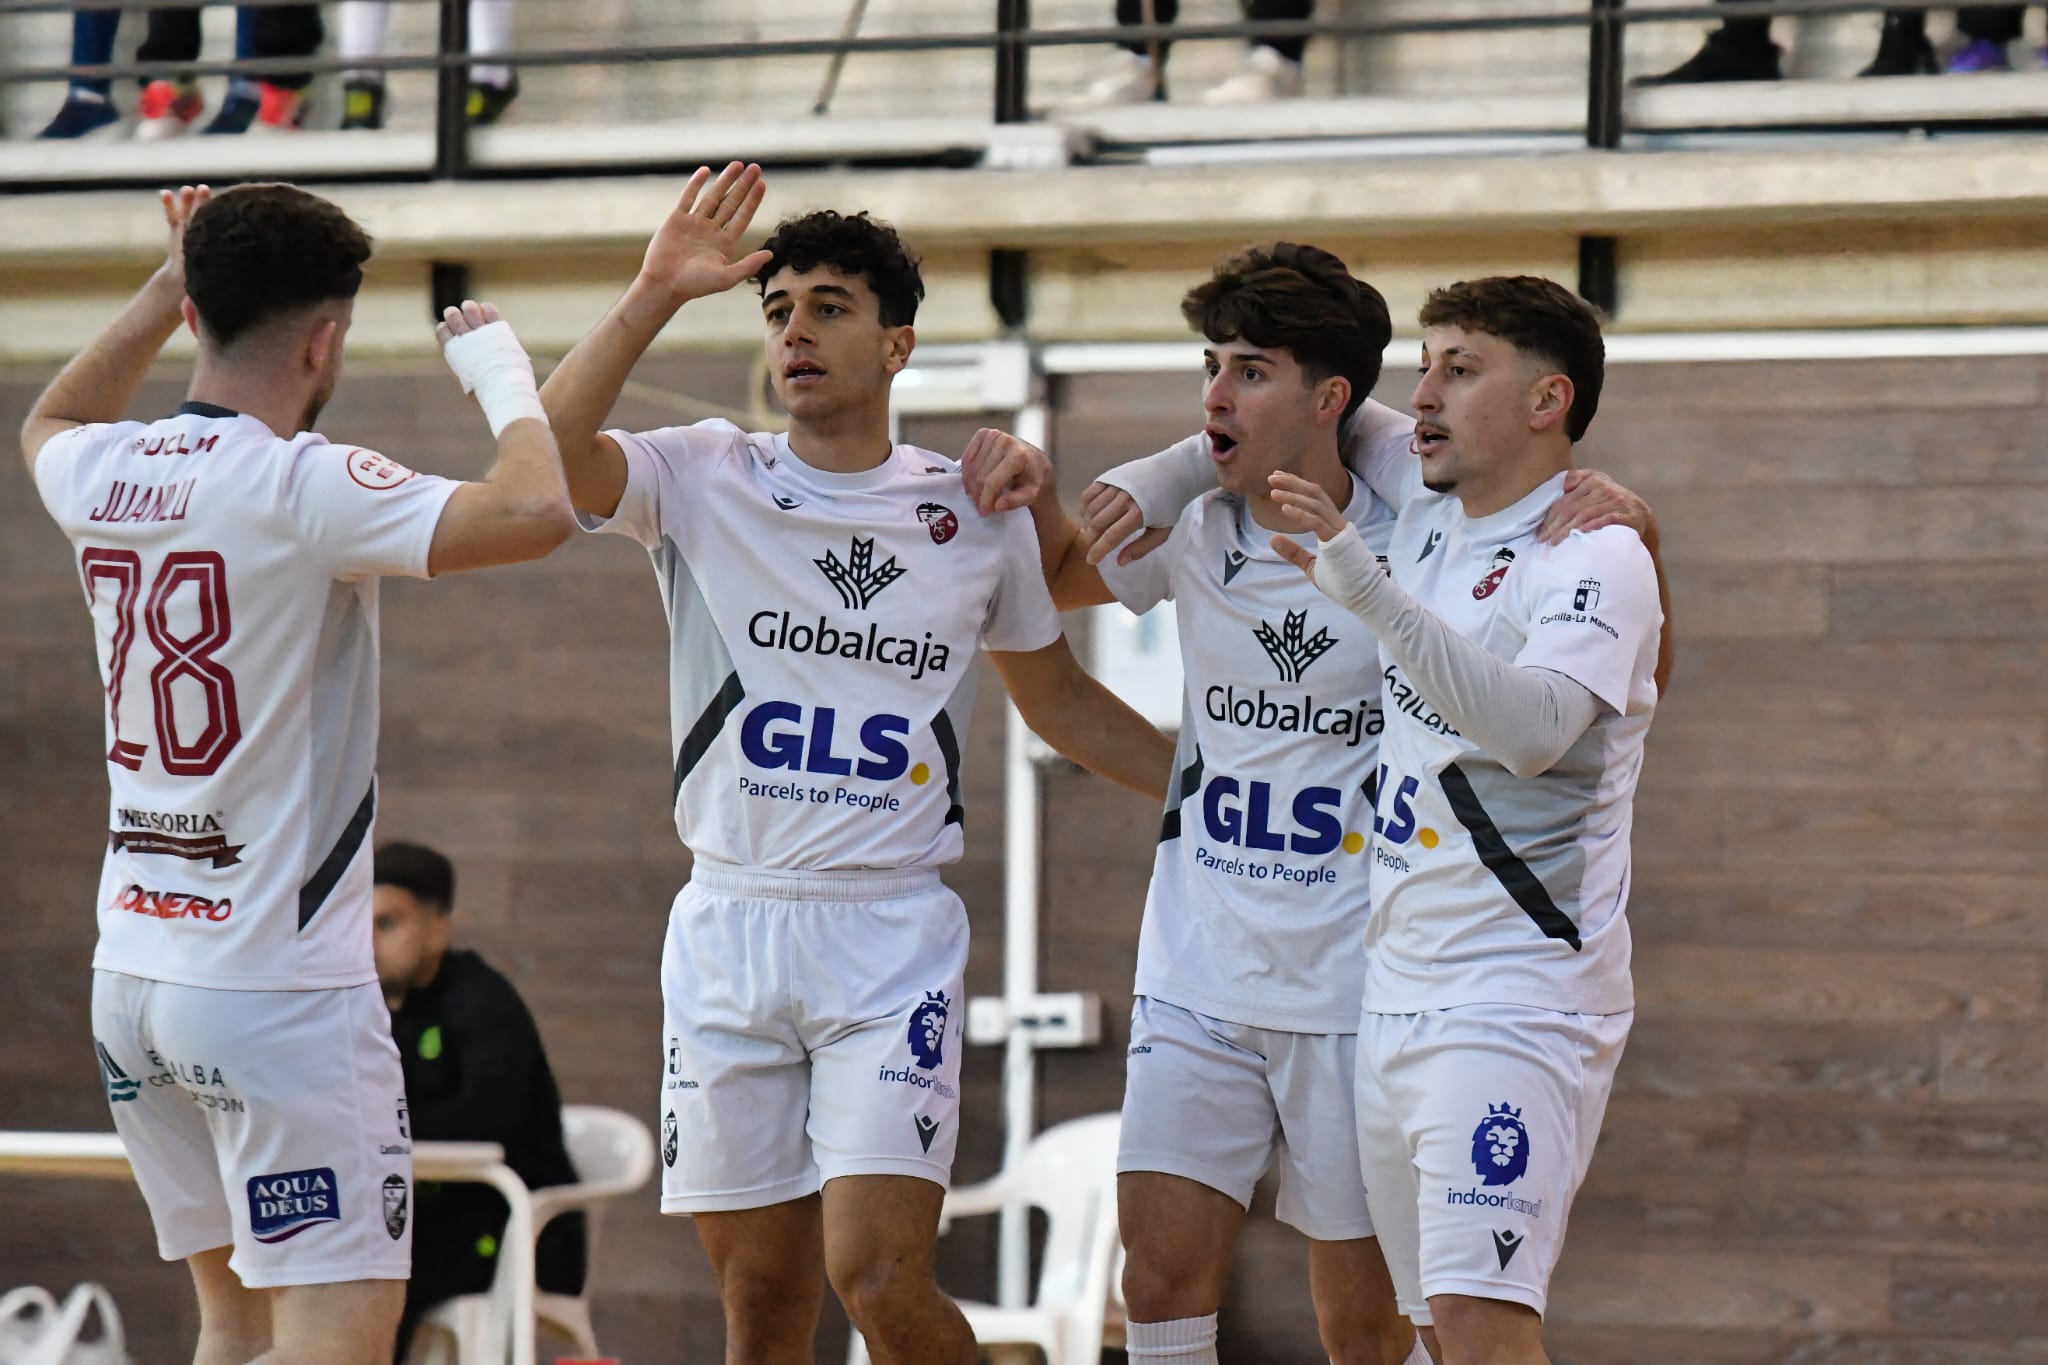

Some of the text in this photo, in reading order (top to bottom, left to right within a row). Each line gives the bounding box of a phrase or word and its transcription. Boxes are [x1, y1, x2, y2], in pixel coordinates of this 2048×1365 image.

[1589, 615, 1619, 640] Mancha
[82, 546, 242, 776] 28
[748, 610, 950, 680] Globalcaja
[1206, 684, 1385, 747] Globalcaja
[739, 777, 900, 812] Parcels to People
[1196, 847, 1337, 886] Parcels to People
[1377, 847, 1410, 873] People
[255, 1175, 330, 1200] AQUA
[1446, 1187, 1542, 1218] indoorland
[260, 1194, 329, 1218] DEUS
